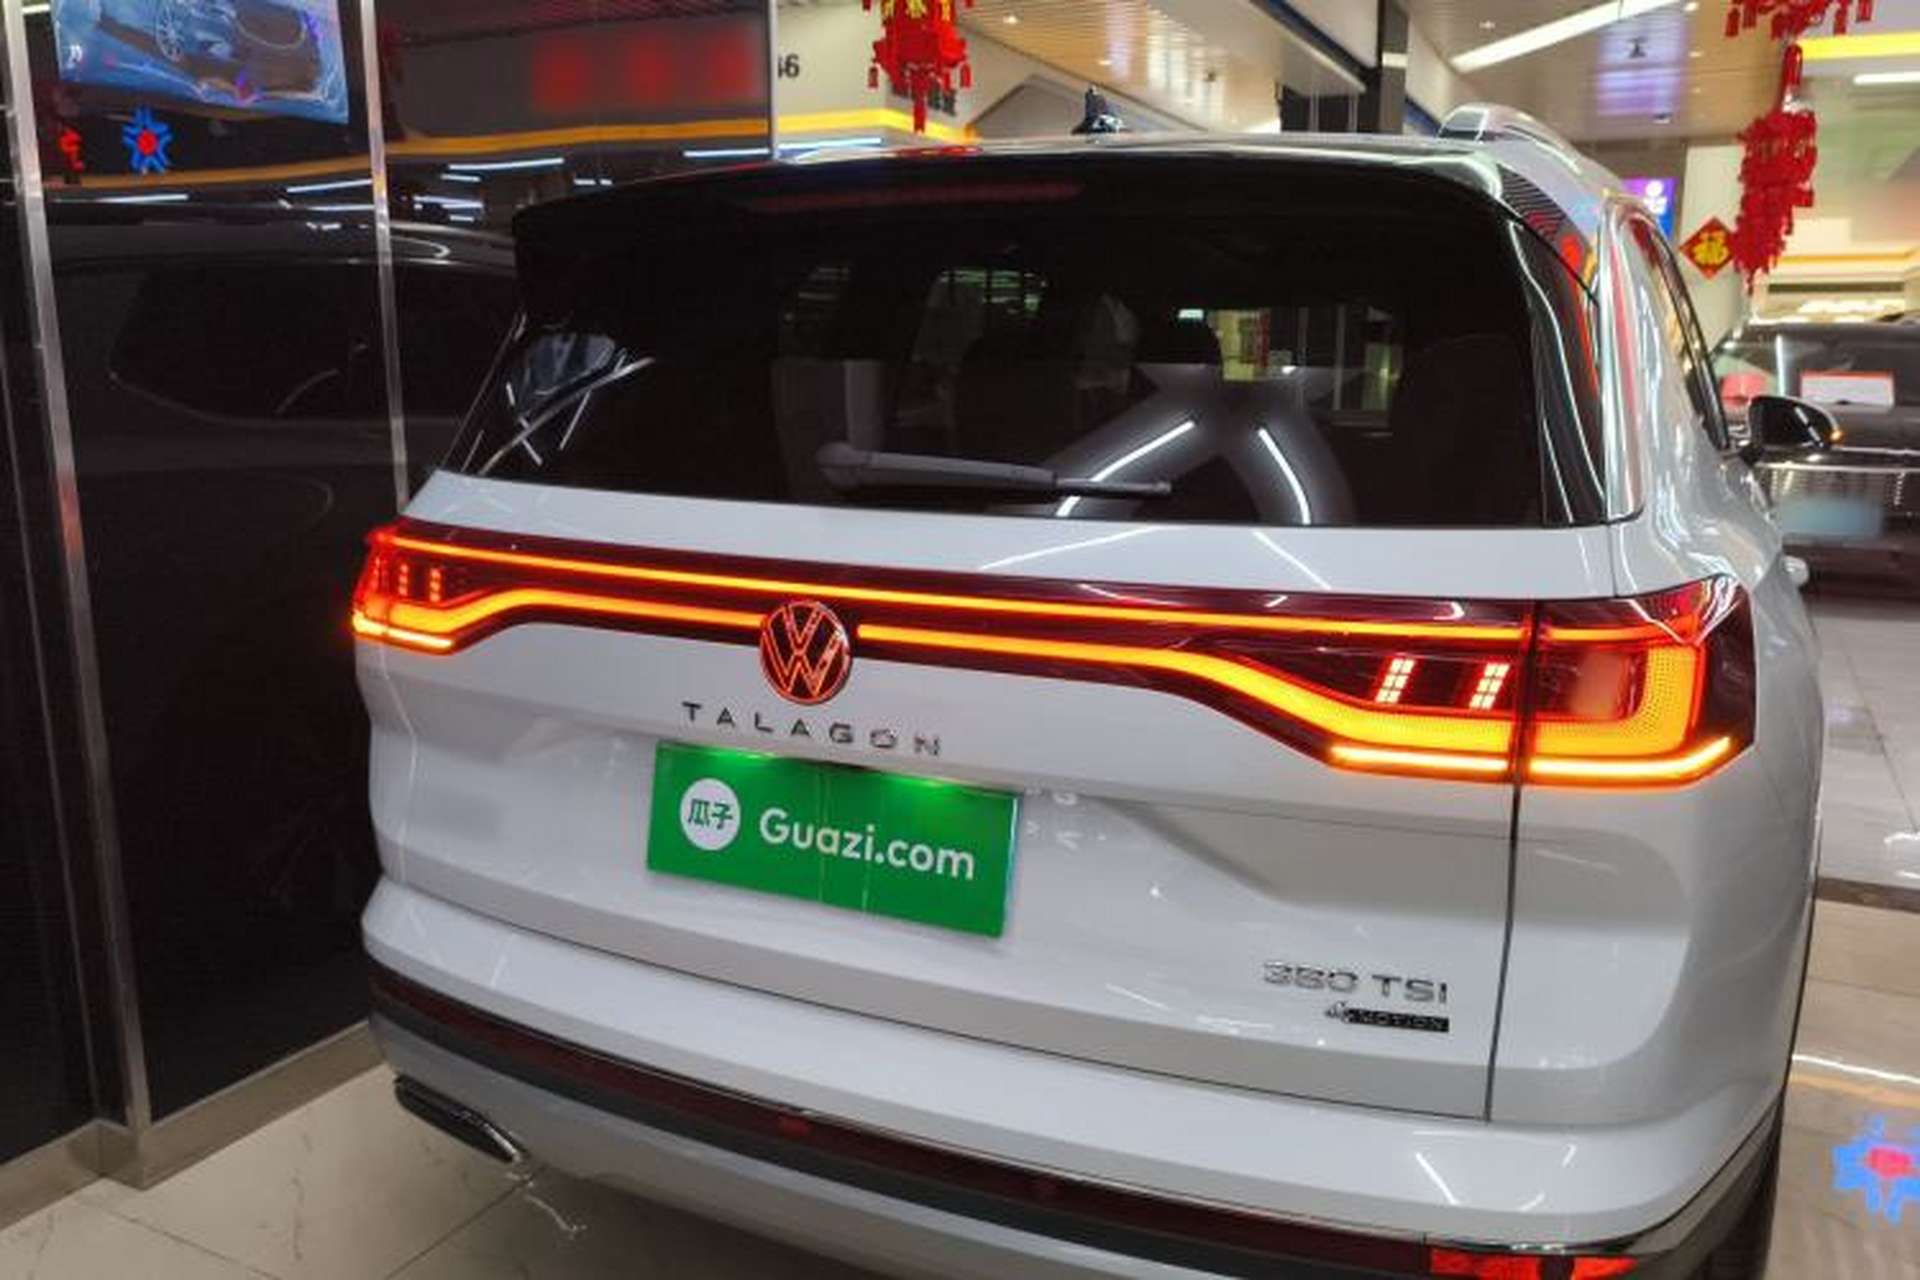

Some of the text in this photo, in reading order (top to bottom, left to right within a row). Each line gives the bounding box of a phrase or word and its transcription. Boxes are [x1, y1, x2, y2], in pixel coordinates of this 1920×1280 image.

[682, 701, 941, 756] TALAGON
[688, 798, 733, 830] 瓜子
[759, 806, 975, 881] Guazi.com
[1371, 974, 1447, 1003] TSI
